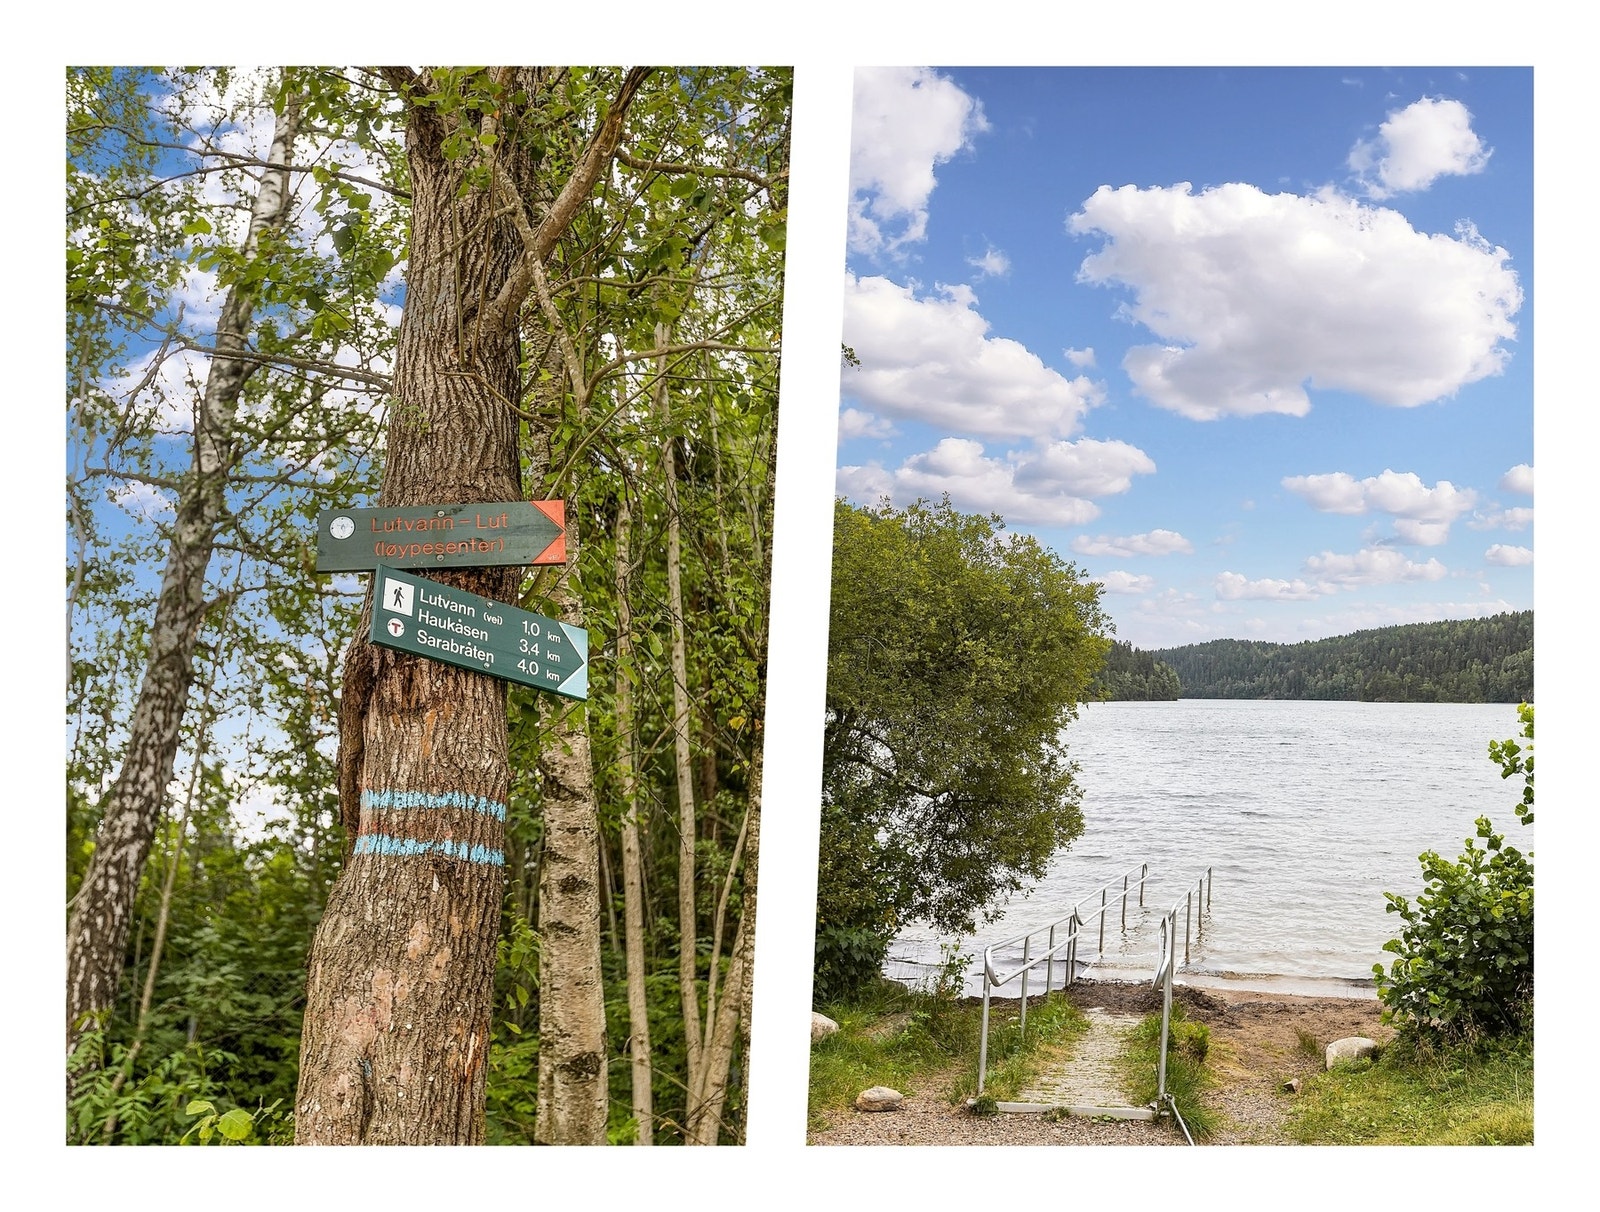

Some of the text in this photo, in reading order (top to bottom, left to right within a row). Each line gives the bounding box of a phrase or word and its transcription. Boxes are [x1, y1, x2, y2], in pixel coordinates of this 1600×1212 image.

[371, 516, 455, 533] Lutvann
[476, 513, 509, 529] Lut
[374, 537, 504, 559] (løypesenter)
[418, 608, 561, 663] Haukåsen 3,4 km
[419, 588, 561, 643] Lutvann (vei) 1,0 km
[416, 629, 560, 682] Sarabråten 4,0 km
